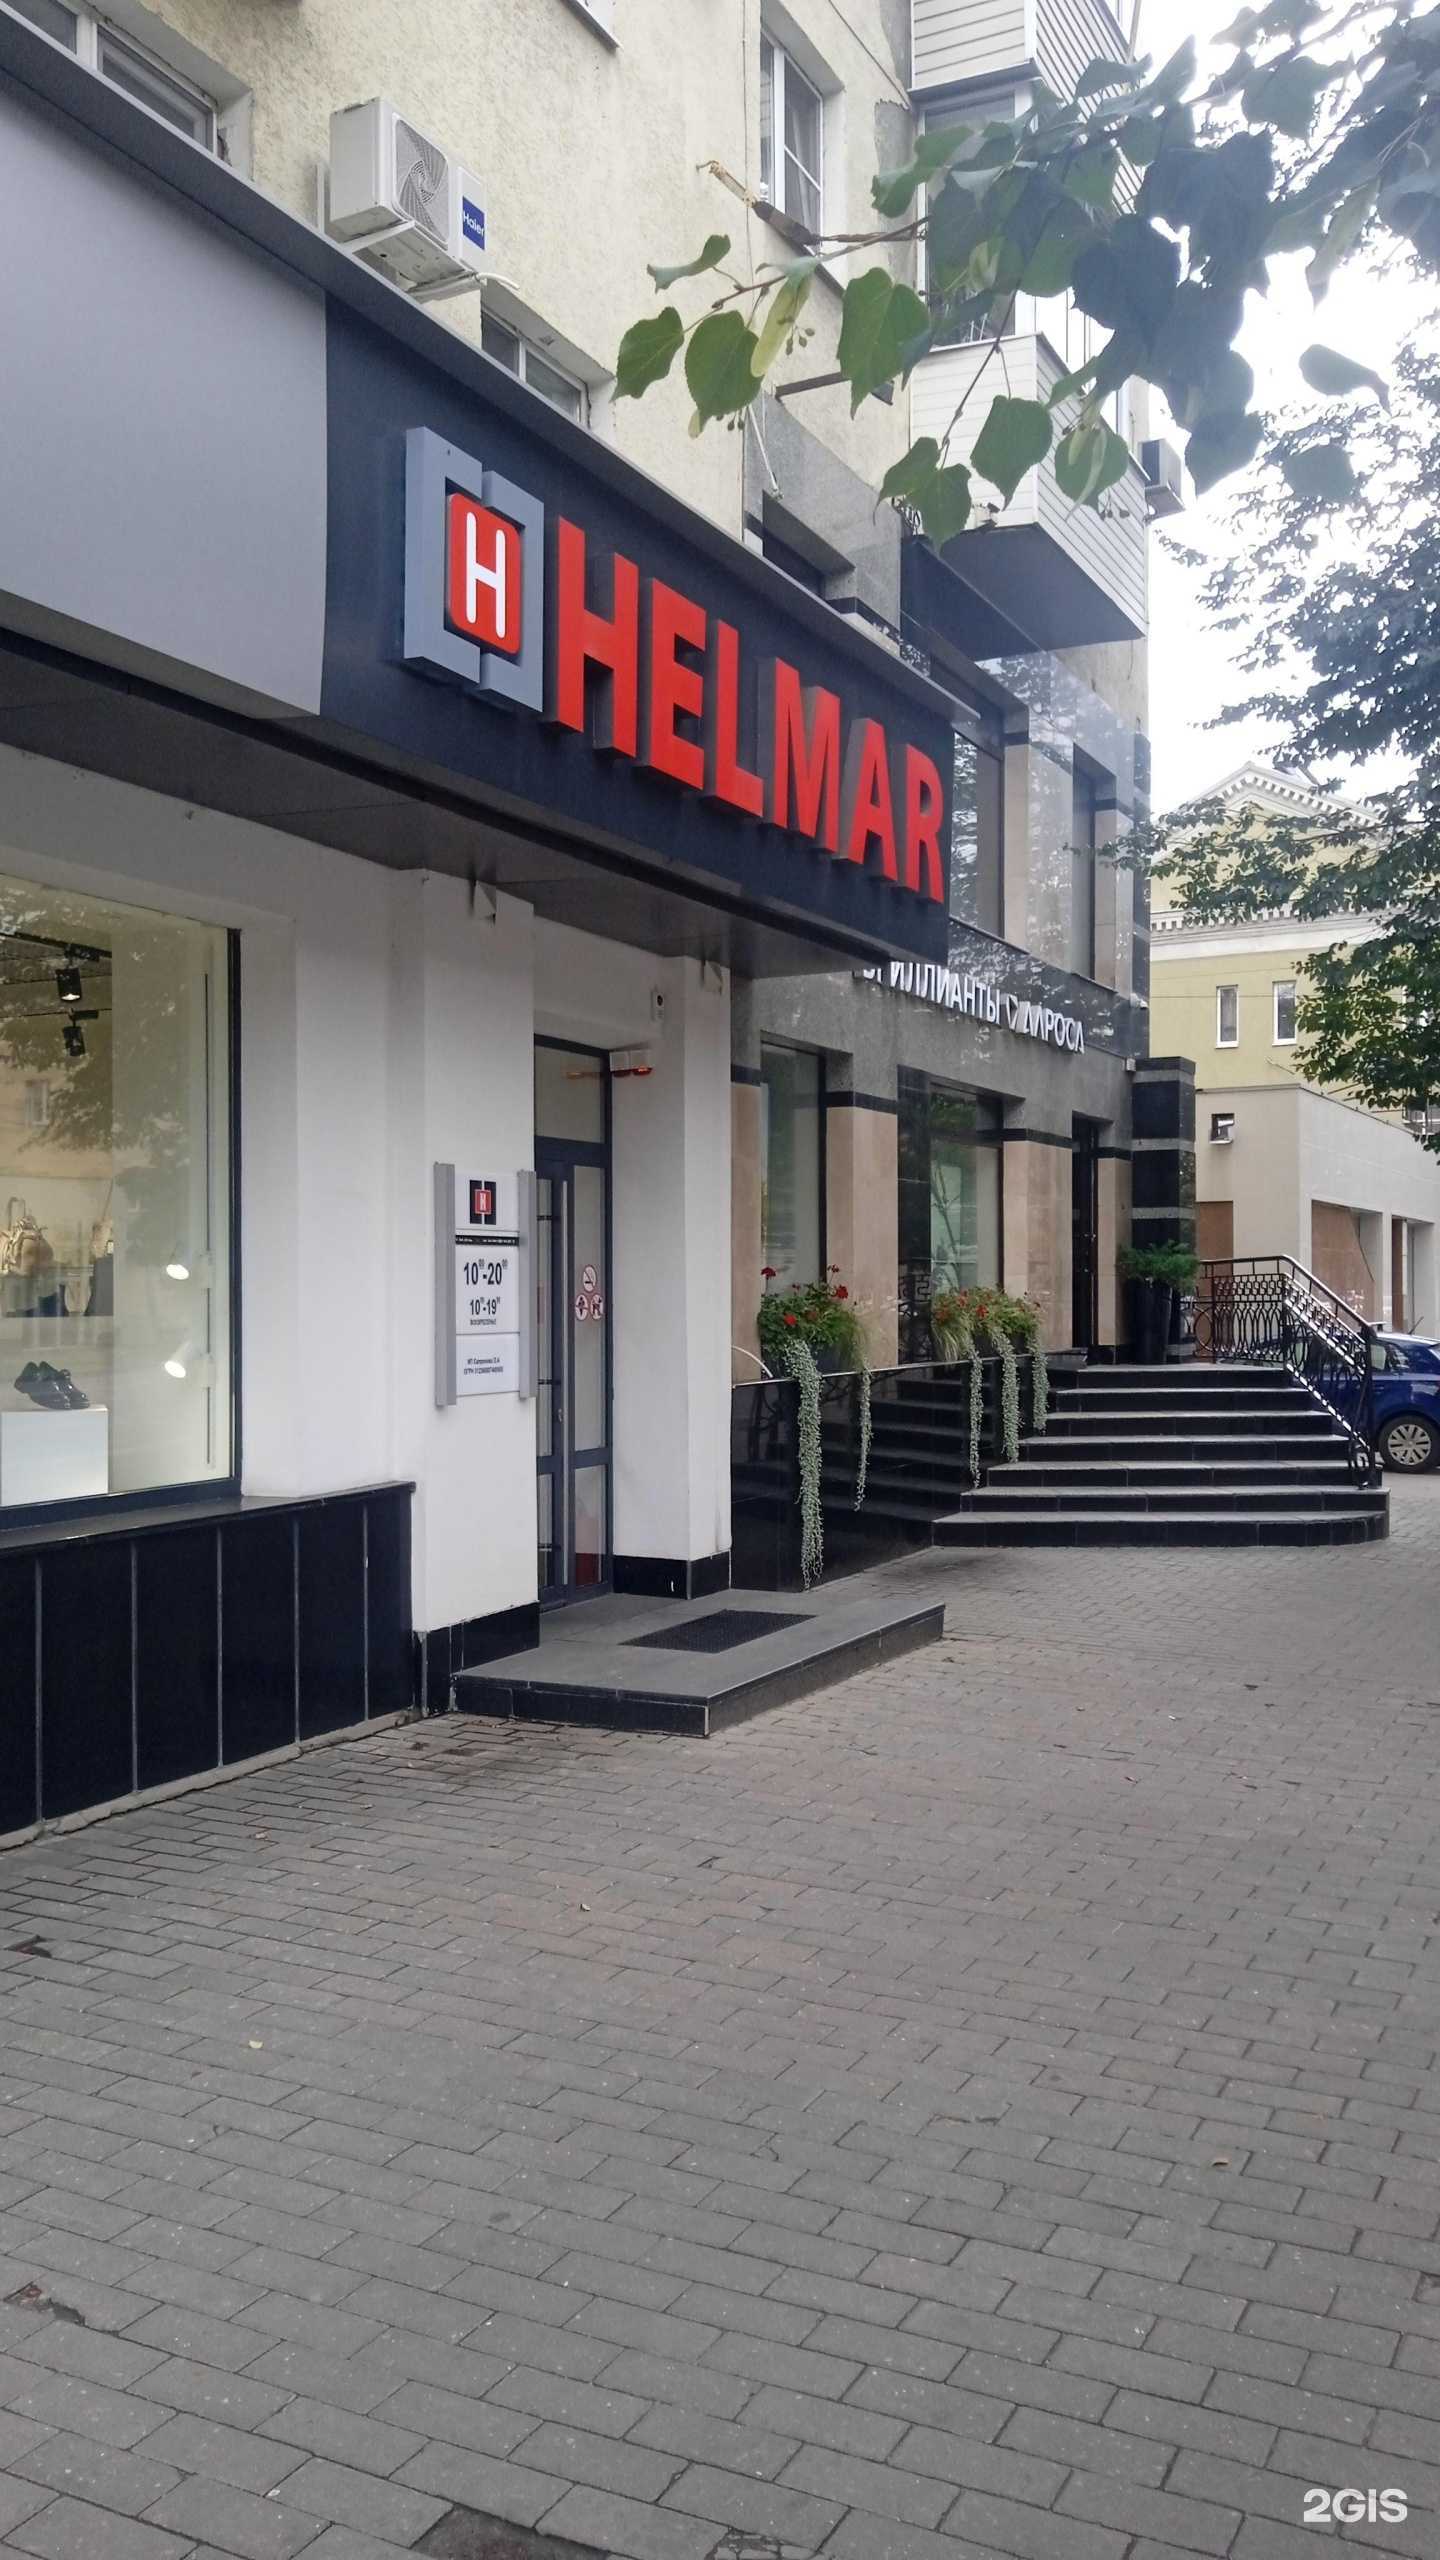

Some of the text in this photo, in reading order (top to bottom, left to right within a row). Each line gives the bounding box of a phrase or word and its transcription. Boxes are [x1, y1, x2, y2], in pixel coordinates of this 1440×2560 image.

[463, 211, 485, 237] Haier
[465, 510, 945, 905] H HELMAR
[862, 960, 1001, 1025] ИЛЛИАНТЫ
